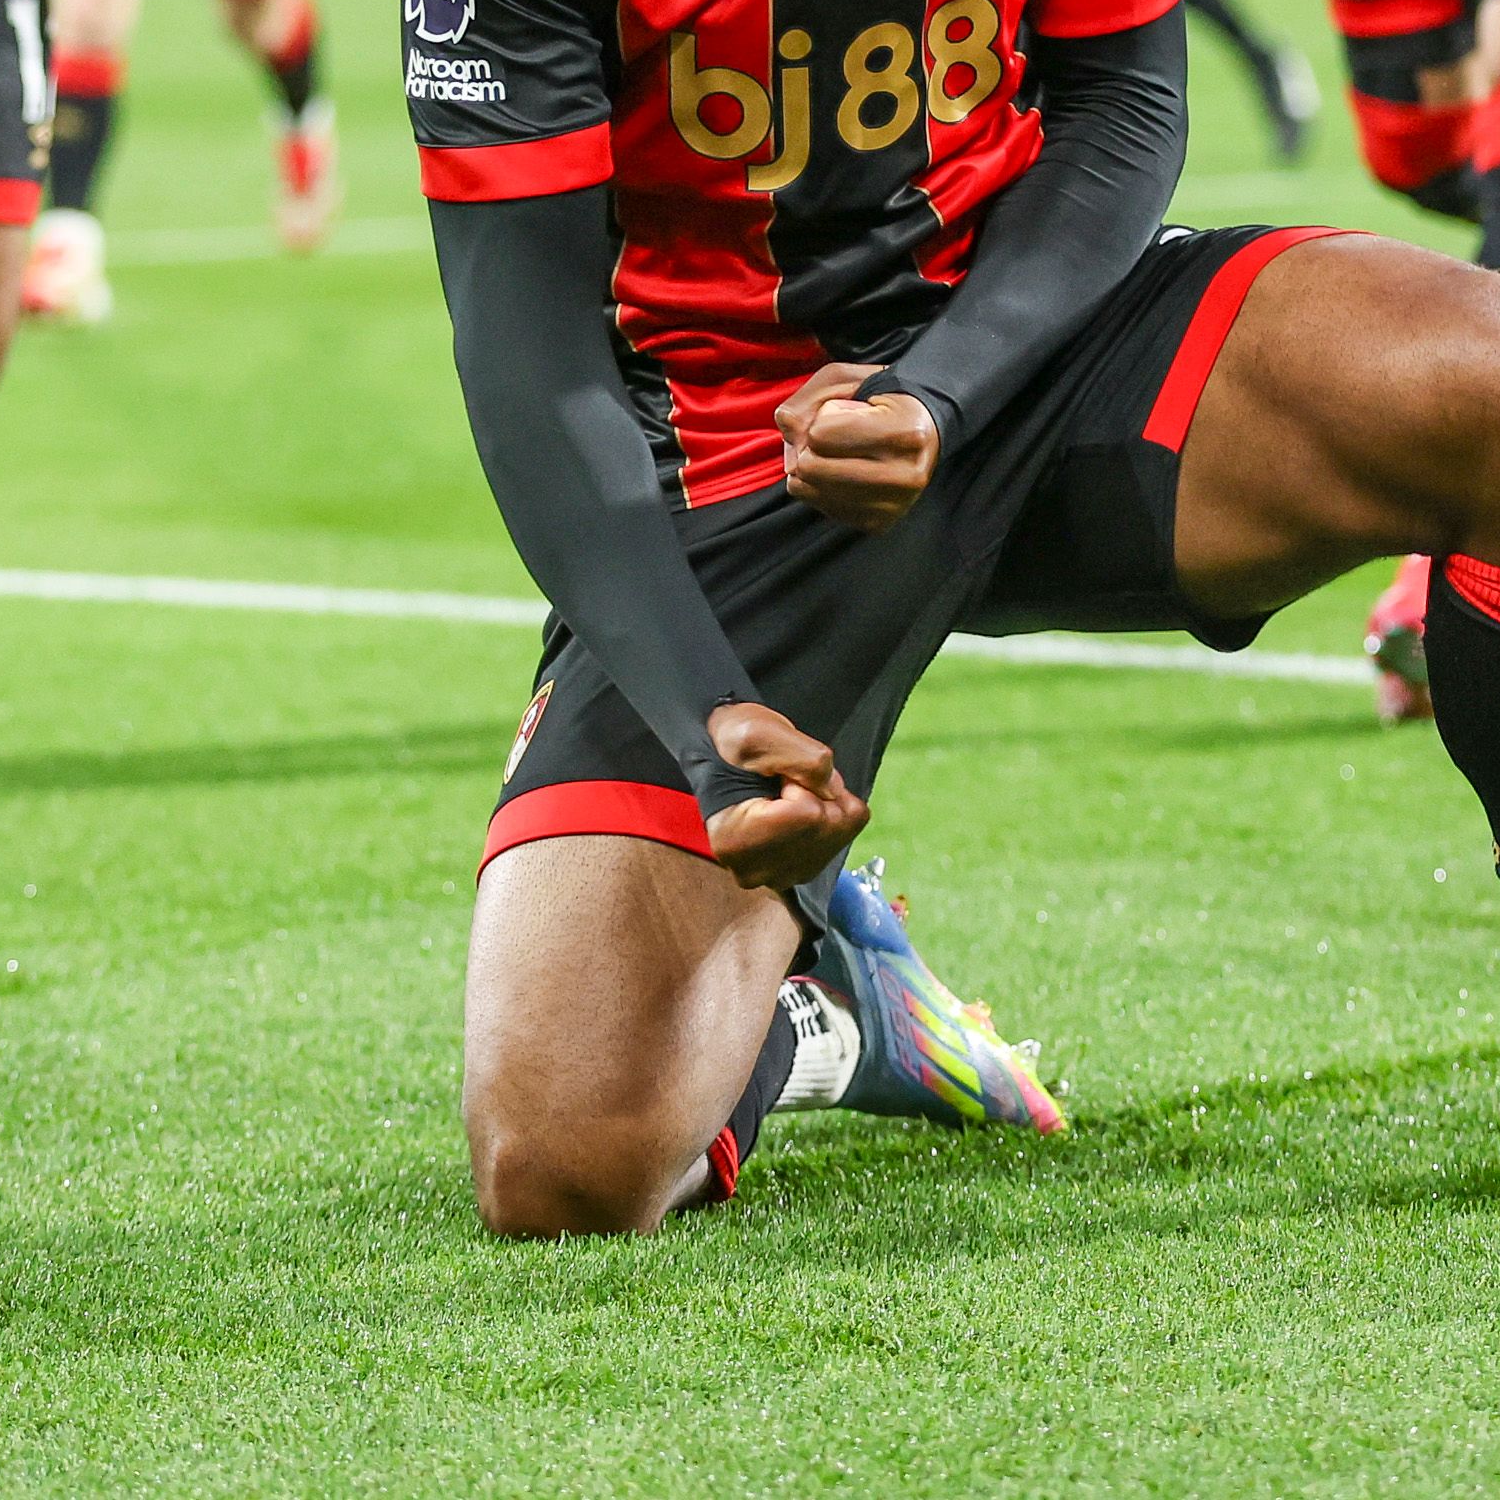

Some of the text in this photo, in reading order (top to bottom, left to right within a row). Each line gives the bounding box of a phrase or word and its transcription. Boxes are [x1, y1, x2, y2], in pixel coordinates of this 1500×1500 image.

[408, 48, 492, 82] No room
[429, 79, 506, 102] racism
